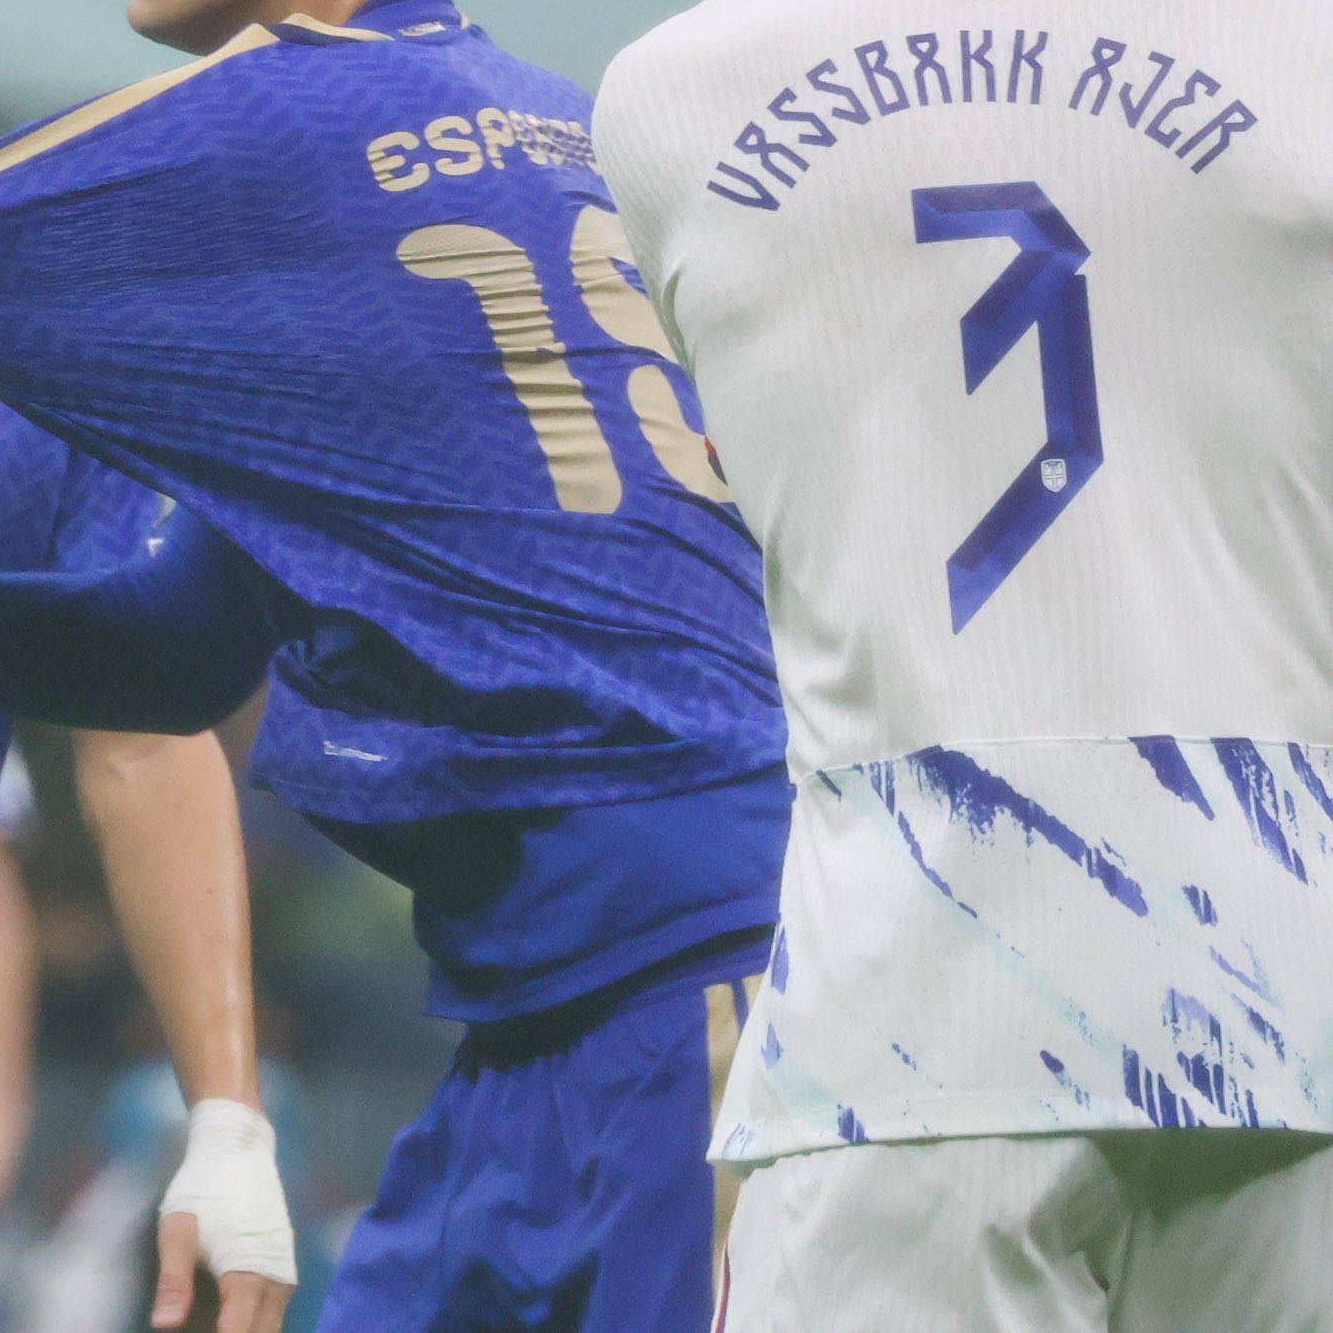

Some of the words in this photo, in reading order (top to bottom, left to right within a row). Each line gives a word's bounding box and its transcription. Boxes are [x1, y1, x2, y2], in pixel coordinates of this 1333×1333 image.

[707, 29, 1050, 212] VASSBAKK
[1069, 35, 1259, 175] AJER
[911, 180, 1104, 635] 3
